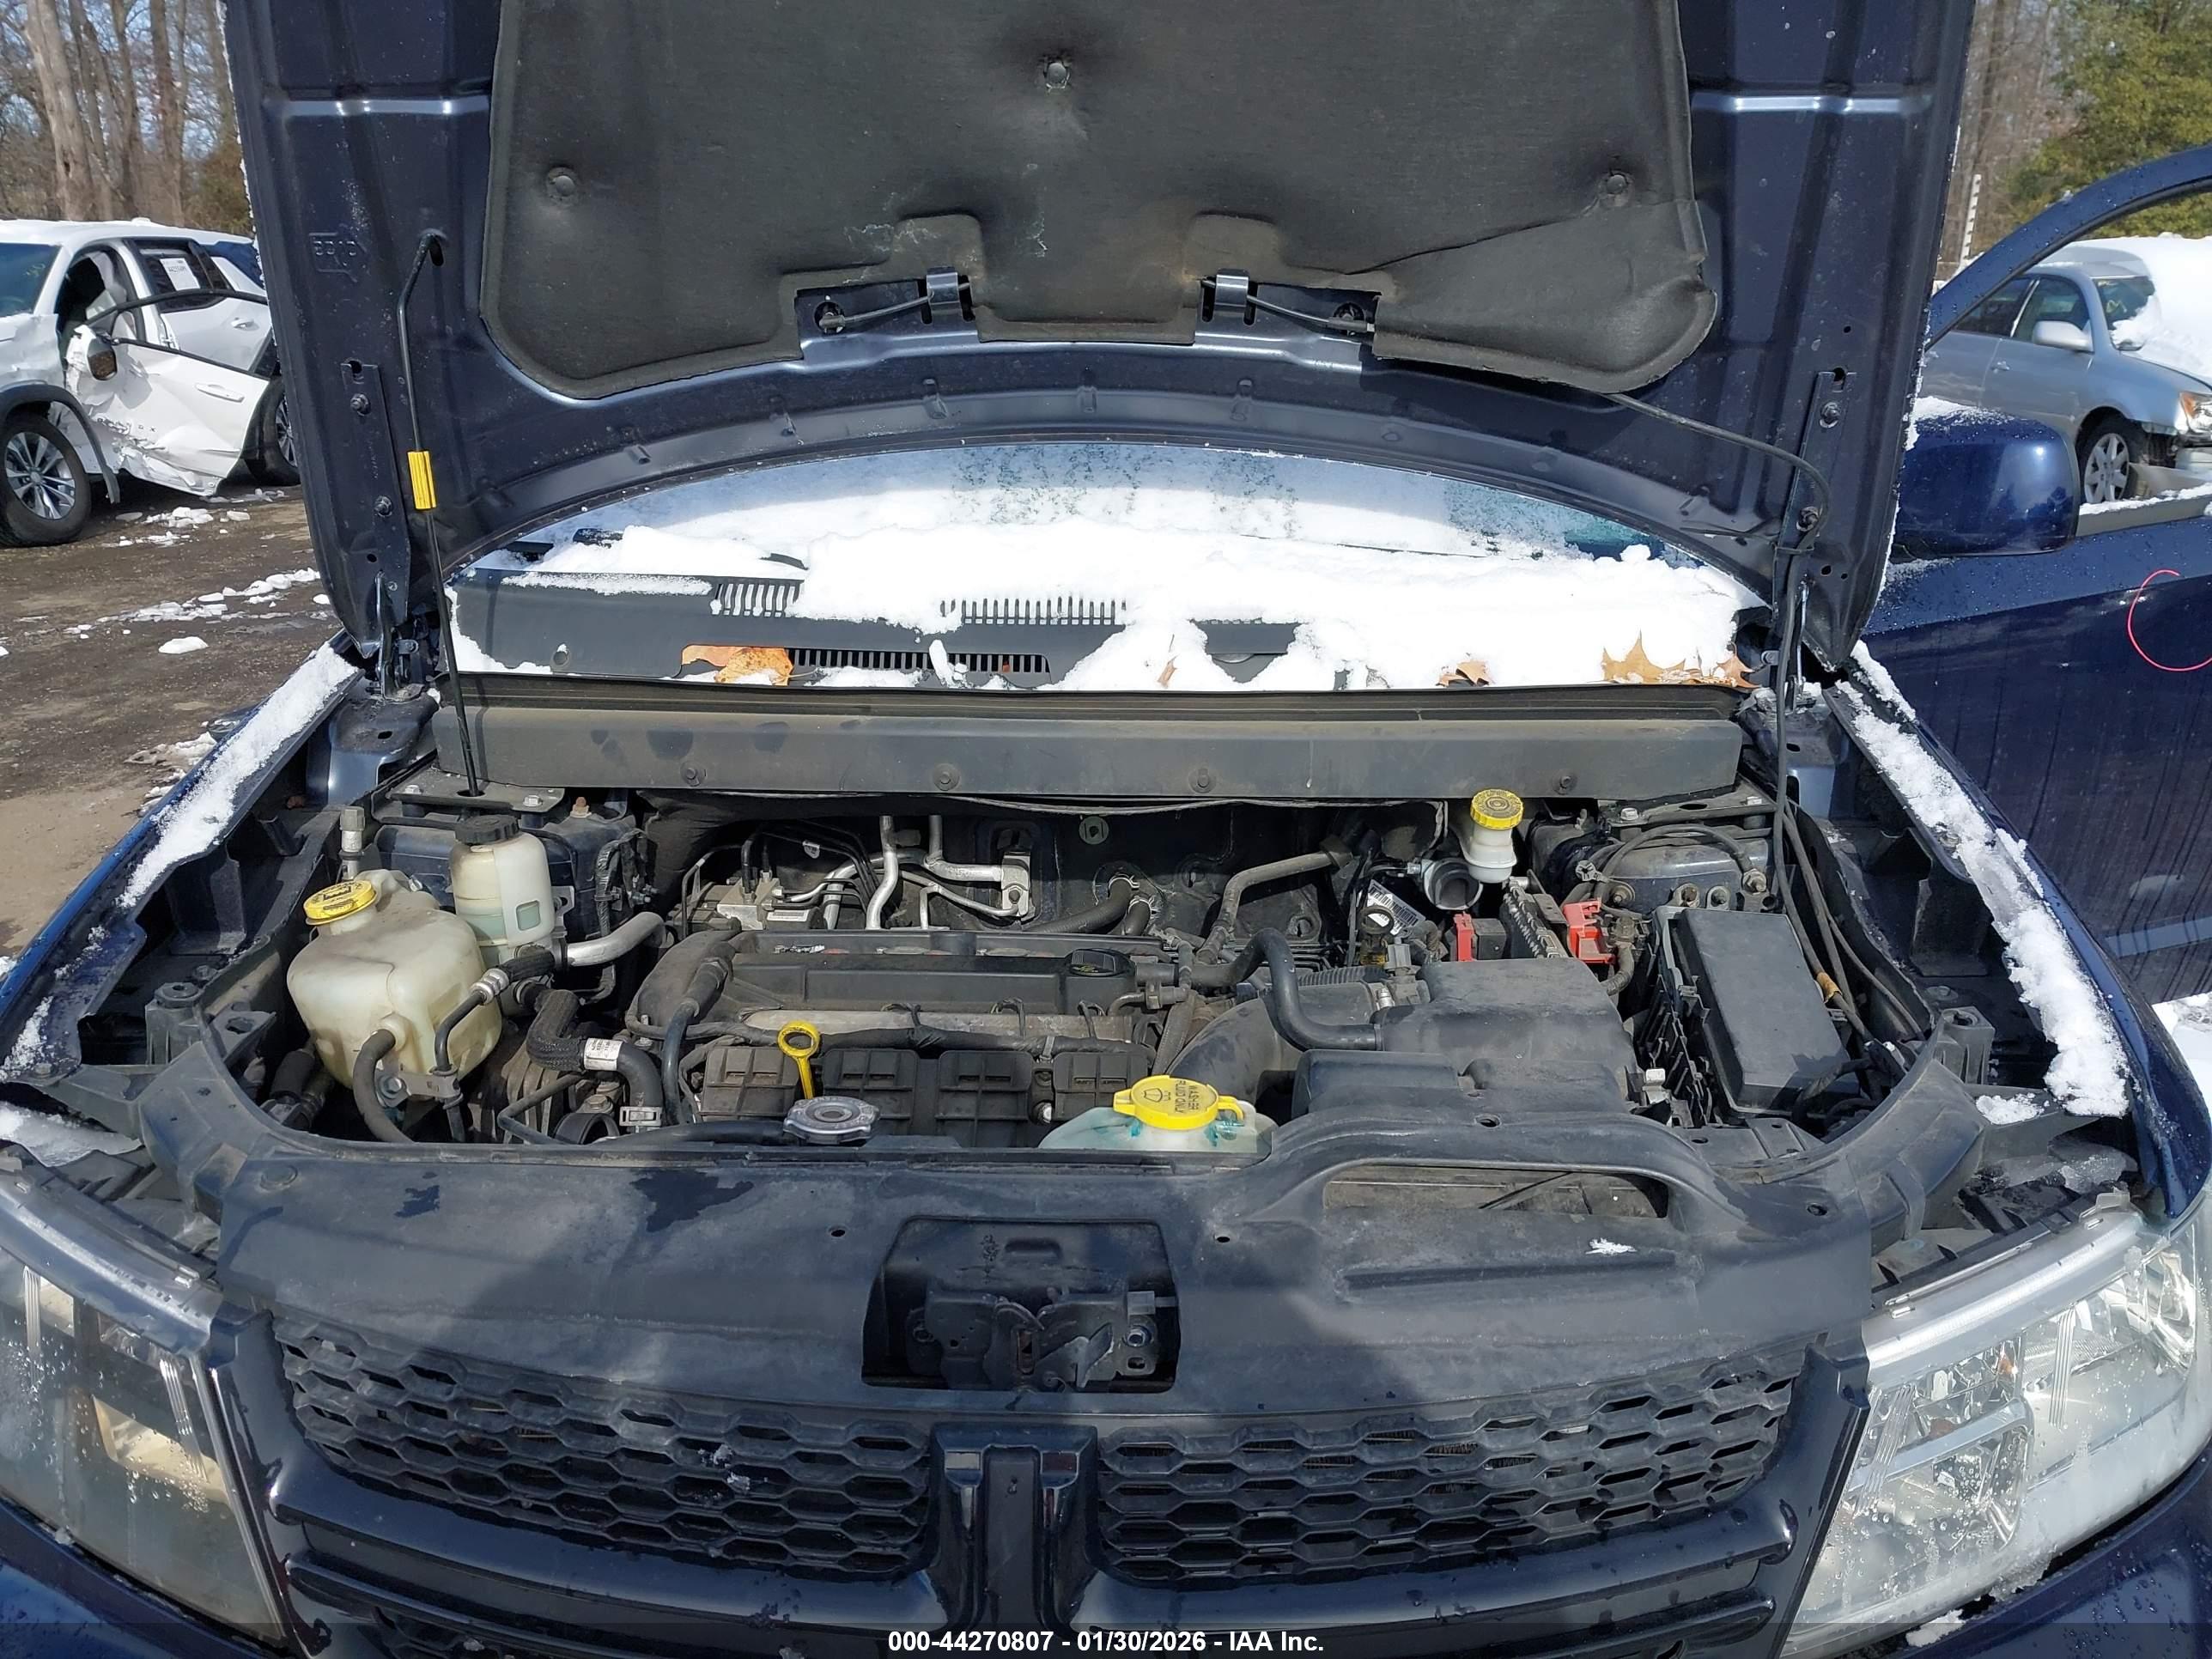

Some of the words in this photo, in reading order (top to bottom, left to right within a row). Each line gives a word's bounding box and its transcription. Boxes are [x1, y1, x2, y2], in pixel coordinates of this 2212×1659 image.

[1175, 1080, 1186, 1097] FLUID
[1175, 1098, 1186, 1114] ONLY
[1188, 1085, 1200, 1110] WASHER
